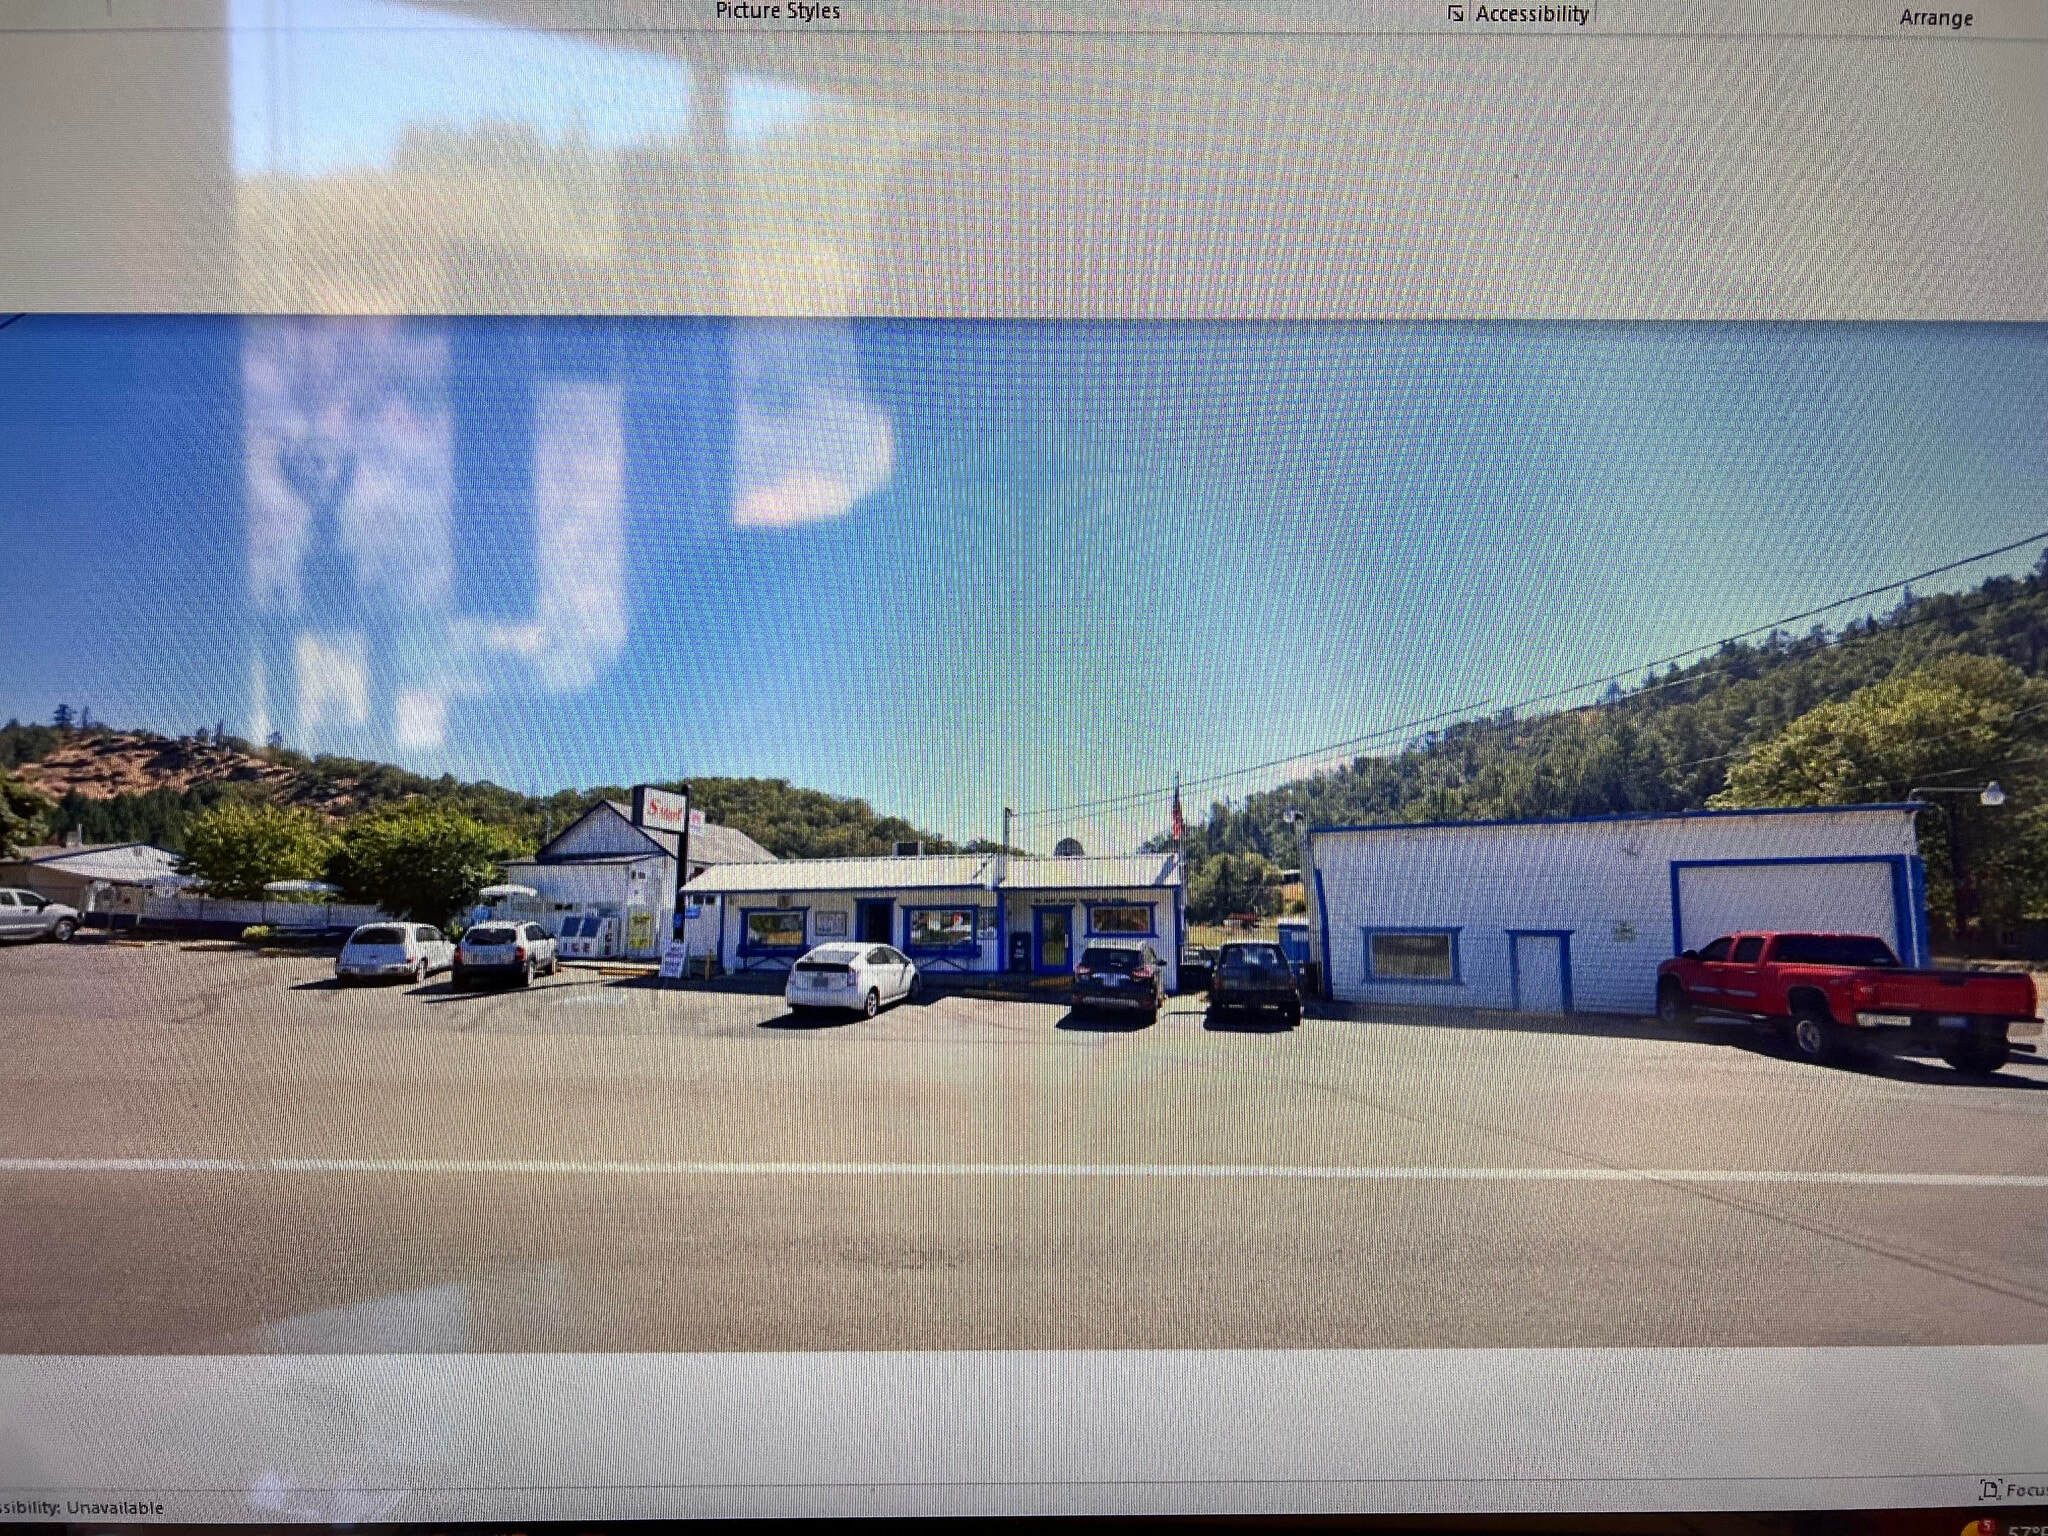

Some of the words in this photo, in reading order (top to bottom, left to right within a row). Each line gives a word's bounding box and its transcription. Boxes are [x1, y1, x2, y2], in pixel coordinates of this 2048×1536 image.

[716, 1, 780, 19] Picture
[787, 1, 841, 22] Styles
[1475, 4, 1590, 25] Accessibility
[1900, 9, 1974, 29] Arrange
[67, 1501, 164, 1515] Unavailable
